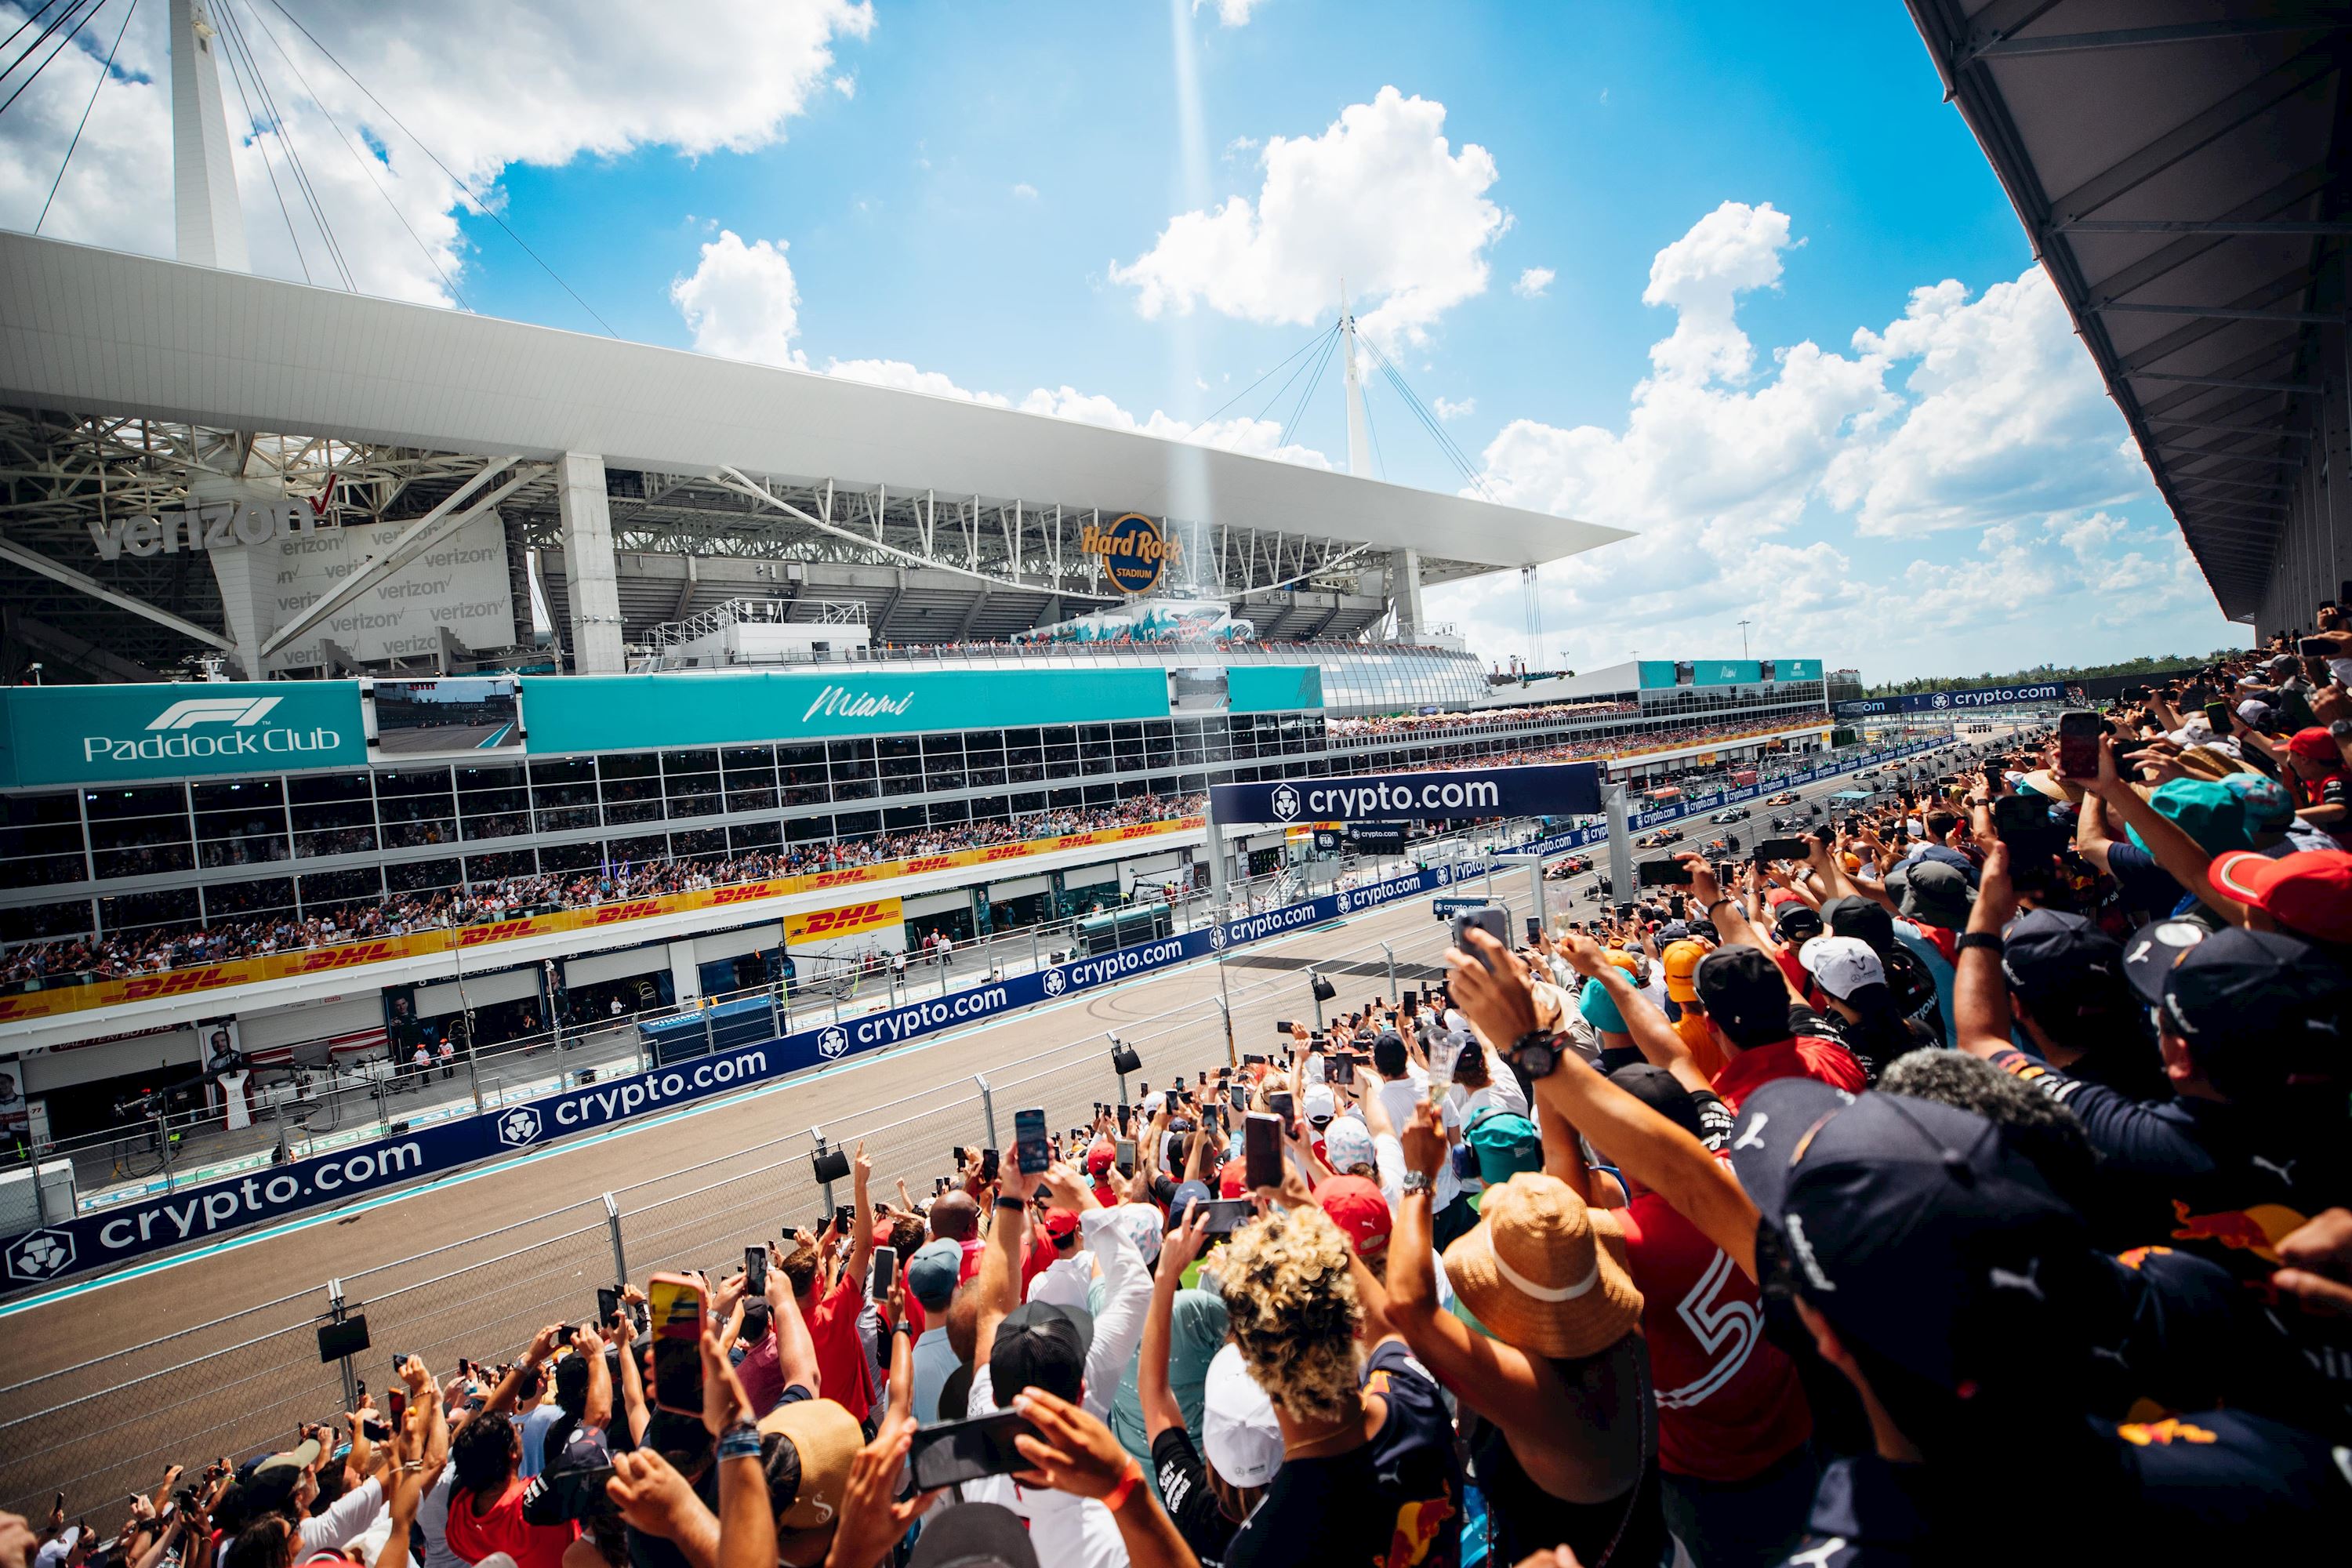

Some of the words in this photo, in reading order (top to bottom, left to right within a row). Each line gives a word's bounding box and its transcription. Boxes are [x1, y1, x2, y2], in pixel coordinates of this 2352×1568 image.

[87, 495, 315, 561] verizon
[1081, 526, 1136, 557] Hard
[1135, 530, 1184, 565] Rock
[424, 547, 493, 568] verizon
[1116, 568, 1152, 579] STADIUM
[376, 579, 446, 600] verizon
[330, 611, 399, 632] verizon
[430, 601, 499, 622] verizon
[383, 635, 439, 655] verizo
[802, 684, 915, 723] Miami
[1954, 681, 2057, 706] crypto.com
[84, 731, 259, 762] Paddock
[263, 728, 340, 752] Club
[1729, 786, 1754, 800] crypto.com
[1762, 779, 1784, 792] crypto.com
[1309, 781, 1499, 817] crypto.com
[1690, 796, 1718, 811] crypto.com
[1643, 807, 1676, 825] crypto.com
[1058, 833, 1095, 848] DHL
[1123, 825, 1156, 839] DHL
[1319, 835, 1333, 845] FIA
[1361, 829, 1399, 839] crypto.com
[986, 844, 1028, 861] DHL
[1526, 834, 1572, 857] crypto.com
[906, 856, 953, 873] DHL
[816, 869, 867, 888] DHL
[713, 884, 771, 904] DHL
[1353, 876, 1421, 906] crypto.com
[595, 901, 663, 924] DHL
[806, 903, 885, 934] DHL
[1036, 915, 1044, 924] 5
[1231, 904, 1316, 941] crypto.com
[459, 920, 541, 946] DHL
[302, 943, 393, 971] DHL
[1072, 940, 1183, 985] crypto.com
[122, 968, 229, 1000] DHL
[649, 1012, 702, 1027] WILLIAMS
[857, 986, 1007, 1044] crypto.com
[555, 1051, 767, 1125] crypto.com
[100, 1142, 422, 1249] crypto.com
[1170, 1477, 1192, 1514] EPSON
